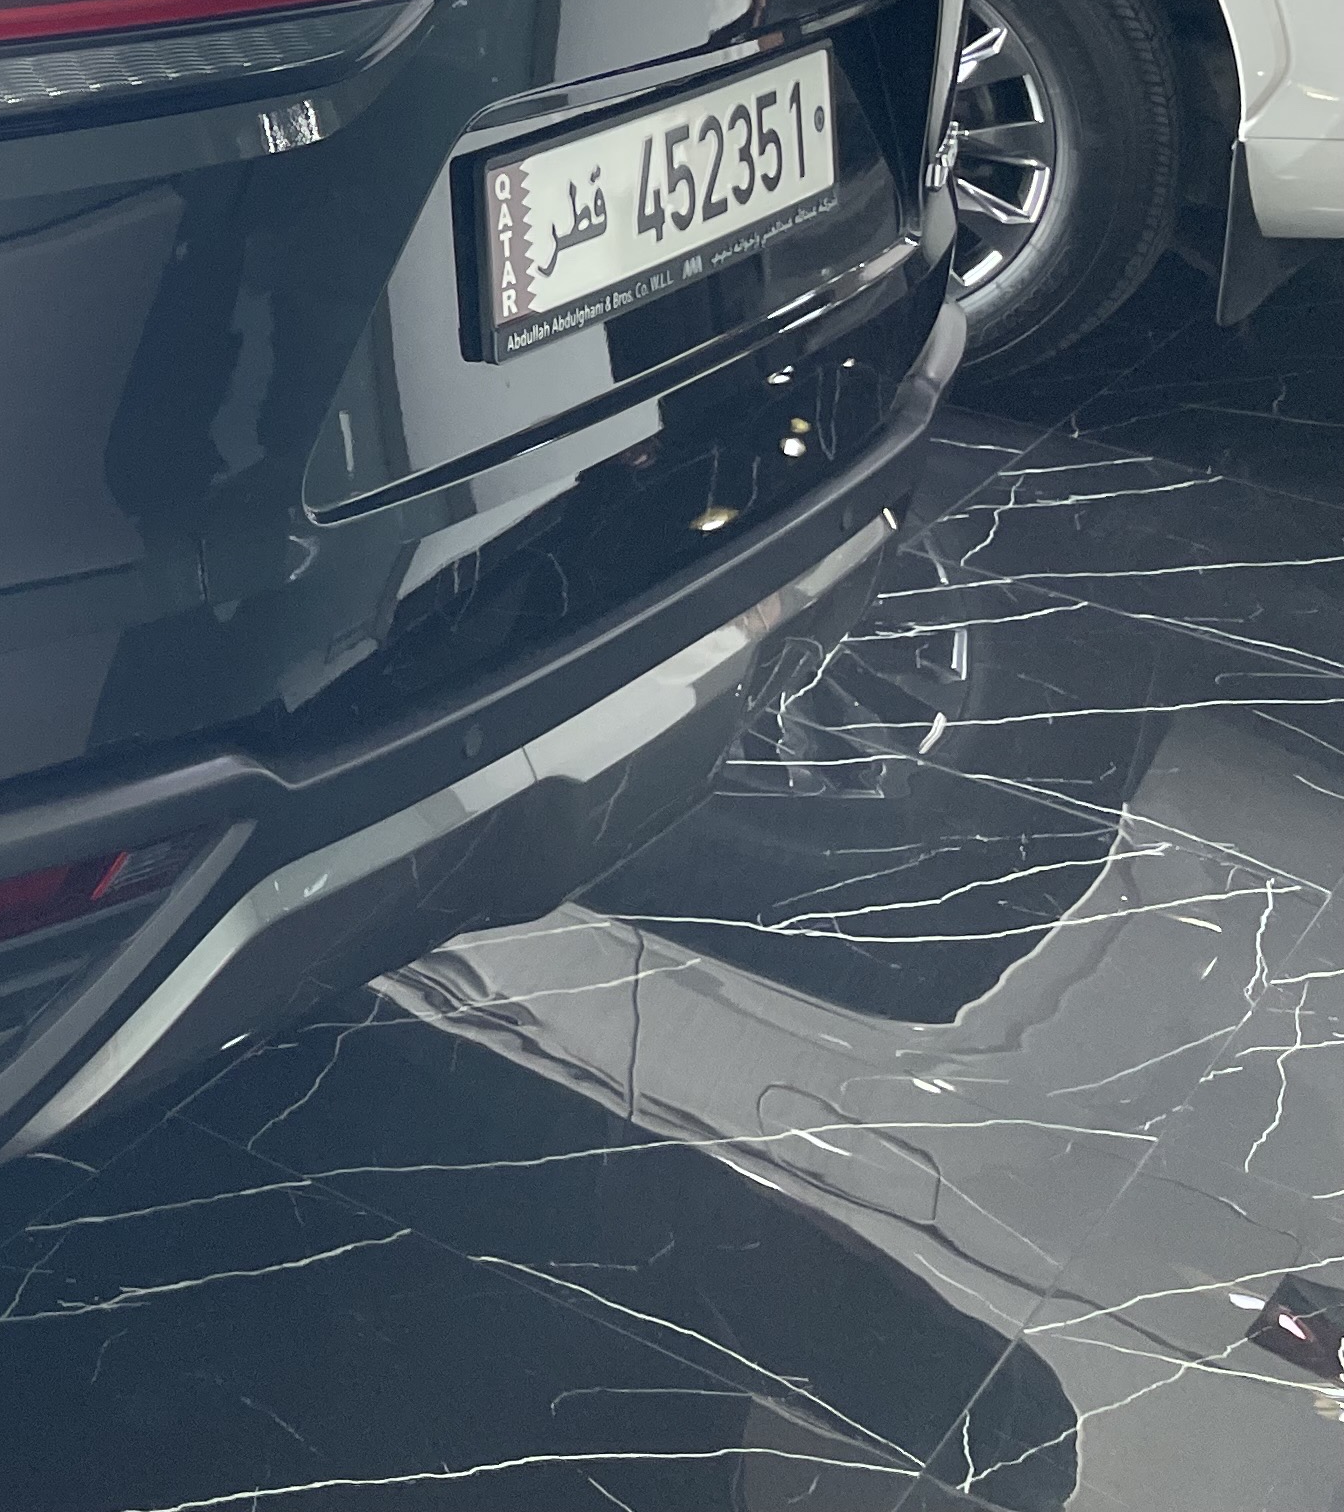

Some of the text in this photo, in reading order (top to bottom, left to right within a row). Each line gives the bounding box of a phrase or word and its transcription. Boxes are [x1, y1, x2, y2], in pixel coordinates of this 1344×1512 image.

[537, 165, 607, 278] قطر
[636, 81, 805, 242] 452351
[494, 173, 518, 317] QATAR
[507, 323, 550, 352] Abdullah
[551, 298, 604, 334] Abdulghani
[604, 296, 612, 312] &
